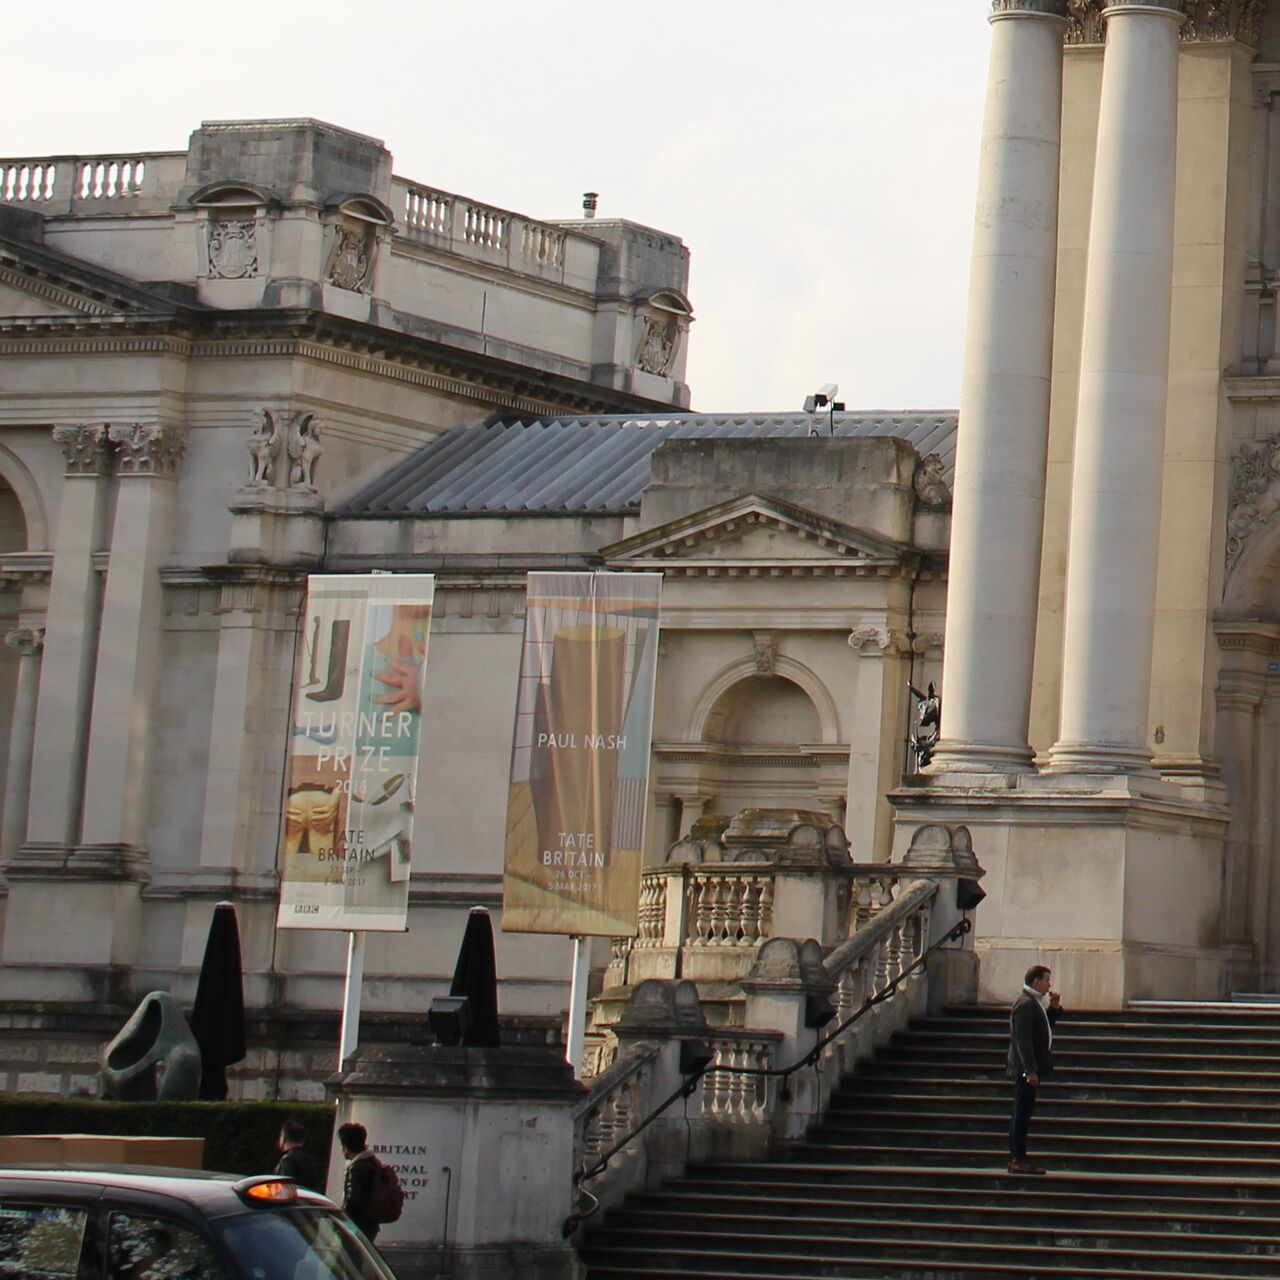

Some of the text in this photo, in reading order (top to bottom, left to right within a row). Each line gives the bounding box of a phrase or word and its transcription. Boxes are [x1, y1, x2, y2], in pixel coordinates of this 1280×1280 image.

[303, 711, 413, 738] TURNER
[537, 732, 628, 750] PAUL NASH
[558, 832, 594, 849] TATE
[318, 848, 375, 863] BRITAIN
[543, 850, 605, 868] BRITAIN
[373, 1144, 428, 1155] BRITAIN
[411, 1177, 430, 1188] OF
